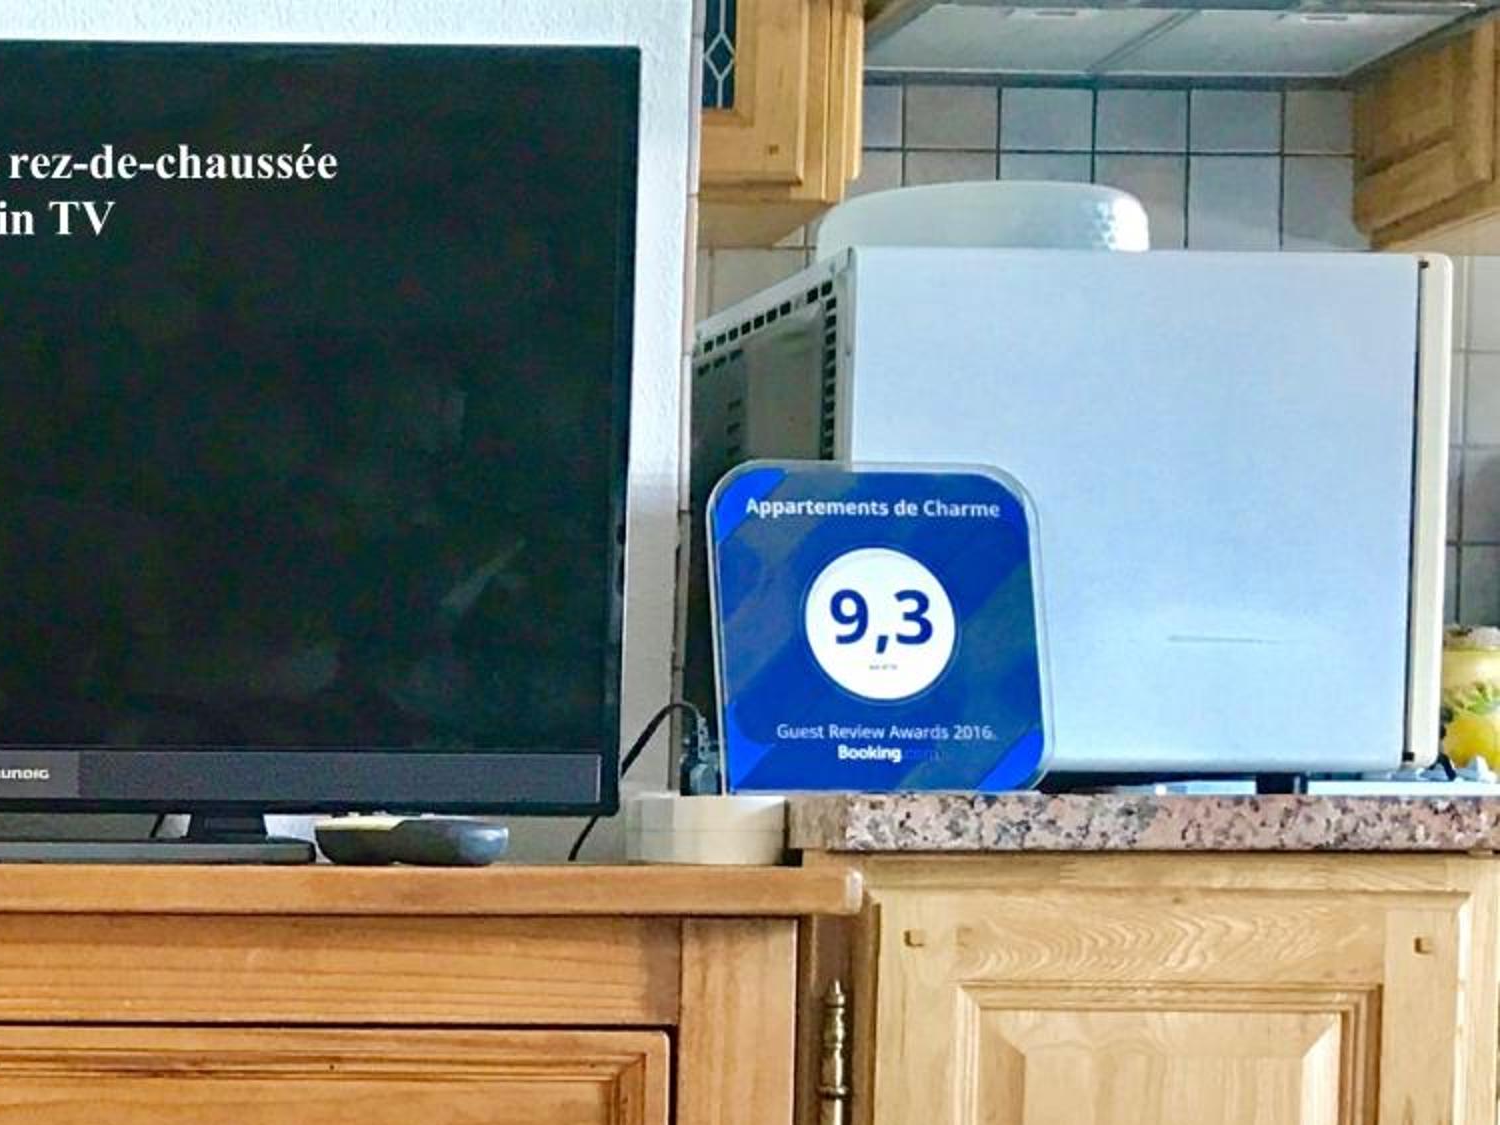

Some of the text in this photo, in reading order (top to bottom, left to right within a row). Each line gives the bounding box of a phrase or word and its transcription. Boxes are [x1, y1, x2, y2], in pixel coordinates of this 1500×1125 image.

[746, 498, 1001, 518] Appartements de Charme
[829, 589, 934, 655] 9,3
[776, 723, 825, 740] Guest
[829, 723, 885, 740] Review
[889, 724, 949, 741] Awards
